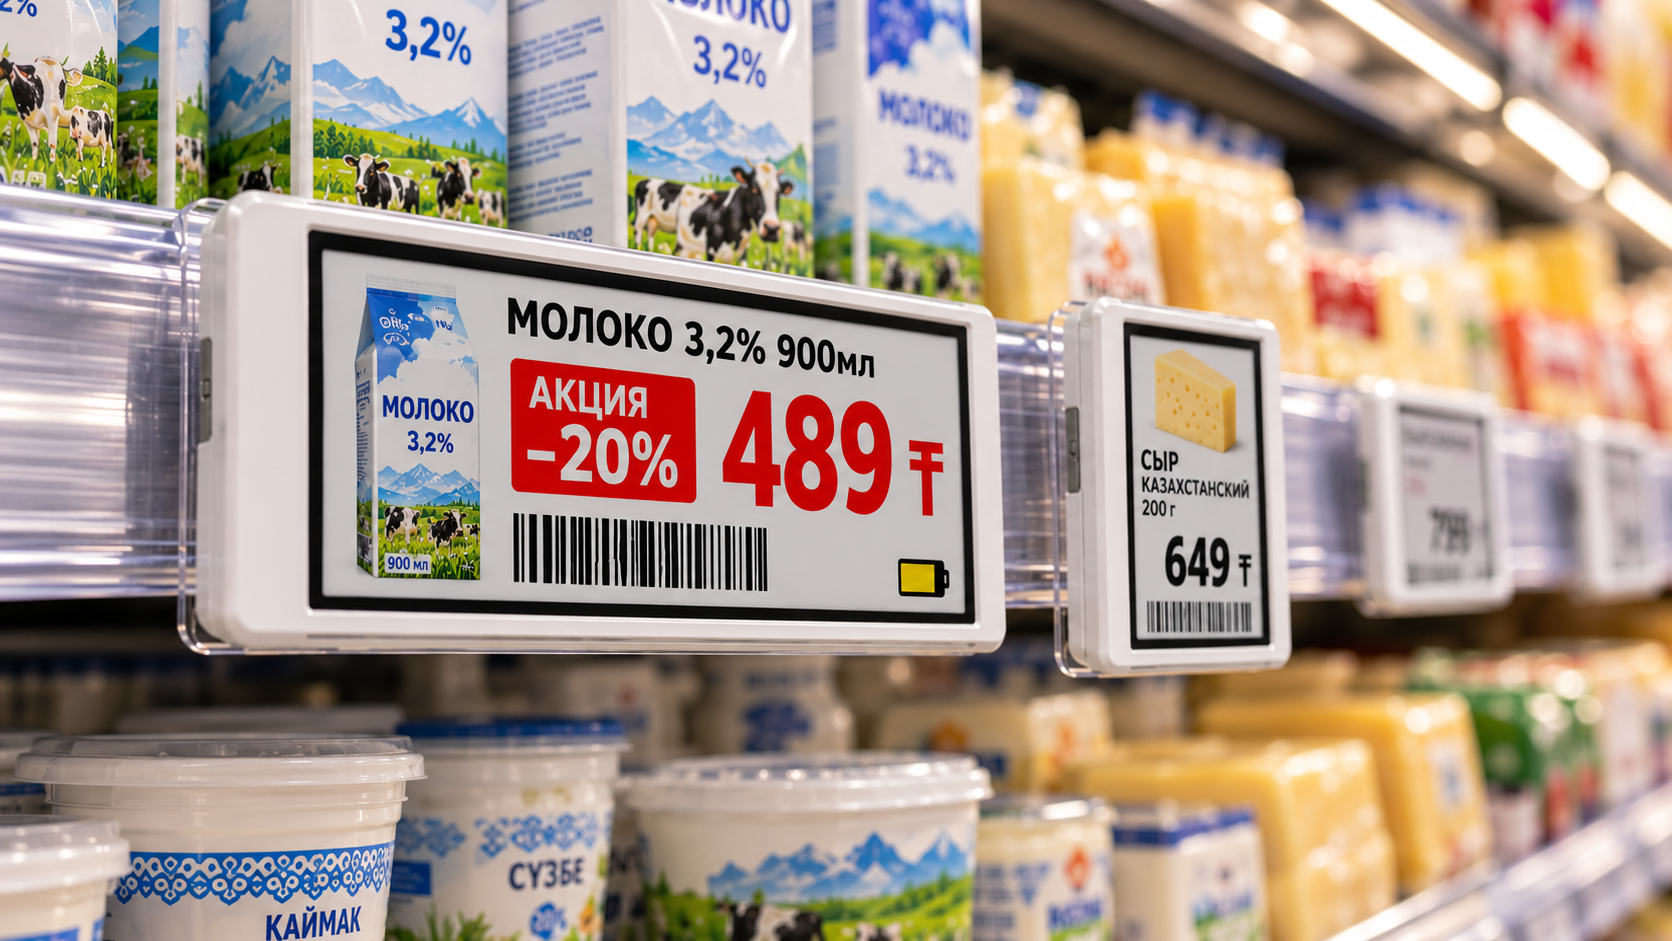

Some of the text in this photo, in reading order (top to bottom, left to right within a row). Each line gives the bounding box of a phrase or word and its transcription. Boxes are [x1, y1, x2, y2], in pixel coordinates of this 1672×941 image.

[385, 9, 471, 65] 3,2%
[693, 35, 766, 88] 3,2%
[508, 297, 673, 352] МОЛОКО
[684, 321, 766, 364] 3,2%
[777, 334, 875, 378] 900мл
[382, 395, 474, 423] МОЛОКО
[529, 375, 647, 421] АКЦИЯ
[407, 430, 454, 455] 3,2%
[722, 390, 892, 515] 489
[1141, 449, 1178, 471] СЫР
[1141, 476, 1250, 499] КАЗАХСТАНСКИЙ
[1142, 499, 1176, 517] 200 г
[387, 556, 429, 571] 900 мл
[1165, 535, 1230, 588] 649
[266, 905, 361, 941] КАЙМАК
